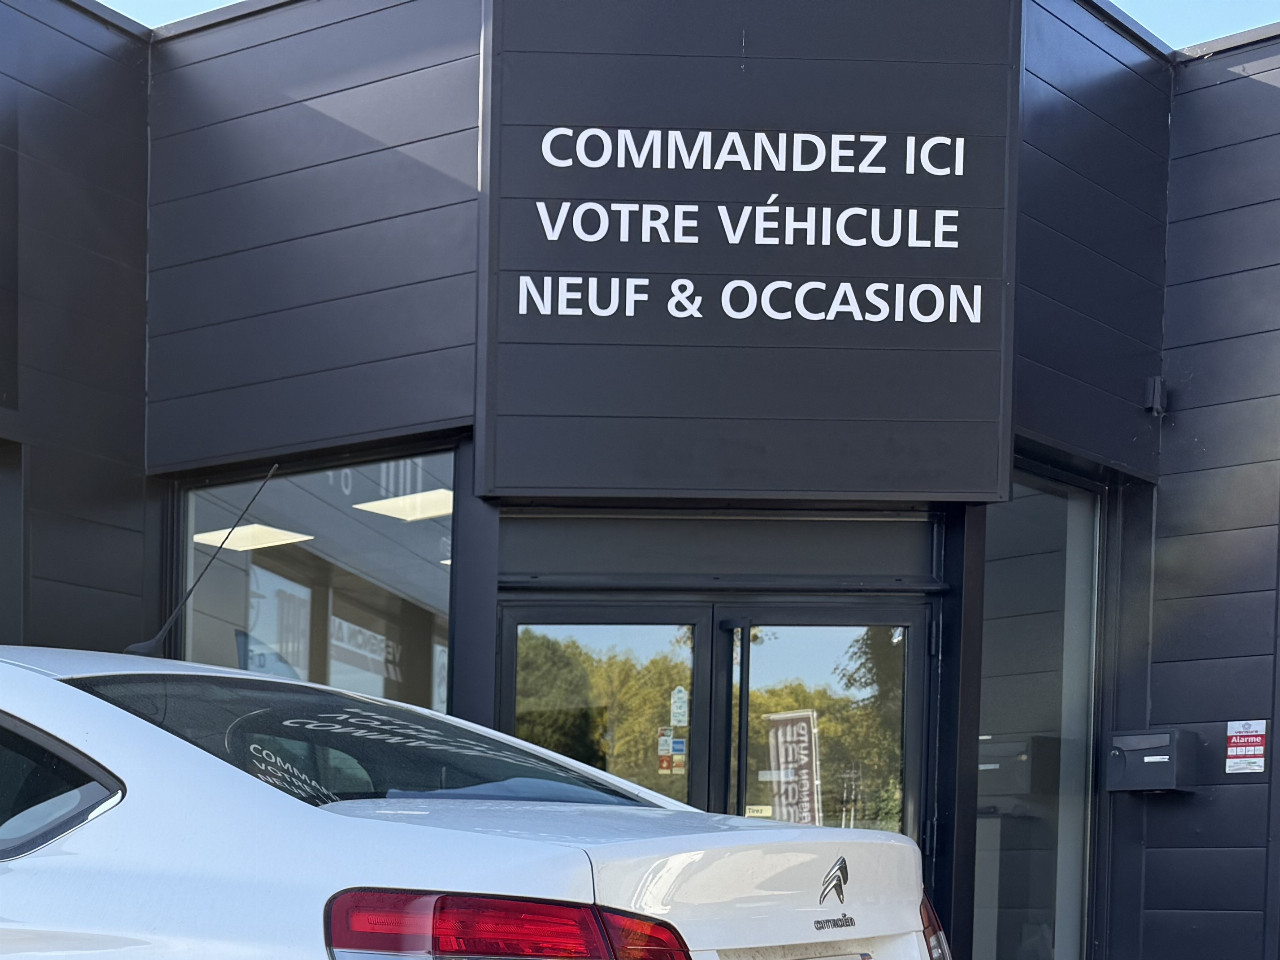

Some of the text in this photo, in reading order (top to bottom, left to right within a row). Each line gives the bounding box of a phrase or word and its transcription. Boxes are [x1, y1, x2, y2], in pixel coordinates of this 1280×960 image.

[541, 127, 965, 176] COMMANDEZ ICI
[535, 193, 959, 249] VOTRE VÉHICULE
[519, 275, 982, 324] NEUF & OCCASION
